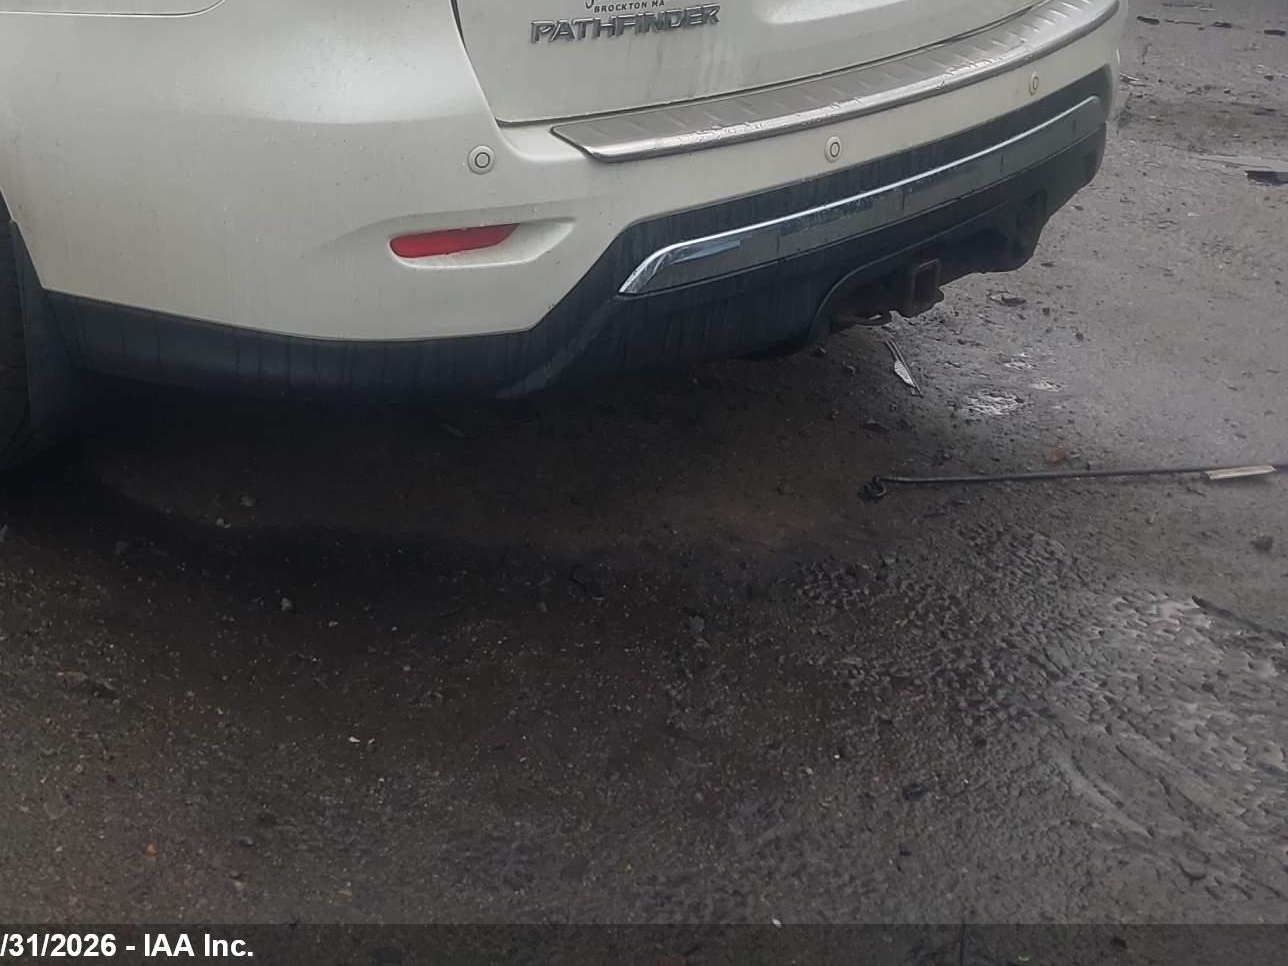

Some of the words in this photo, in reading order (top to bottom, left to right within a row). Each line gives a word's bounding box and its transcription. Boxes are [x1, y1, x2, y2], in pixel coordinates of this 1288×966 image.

[594, 2, 647, 13] BROCKTON
[652, 0, 665, 8] MA
[531, 3, 721, 44] PATHFINDER
